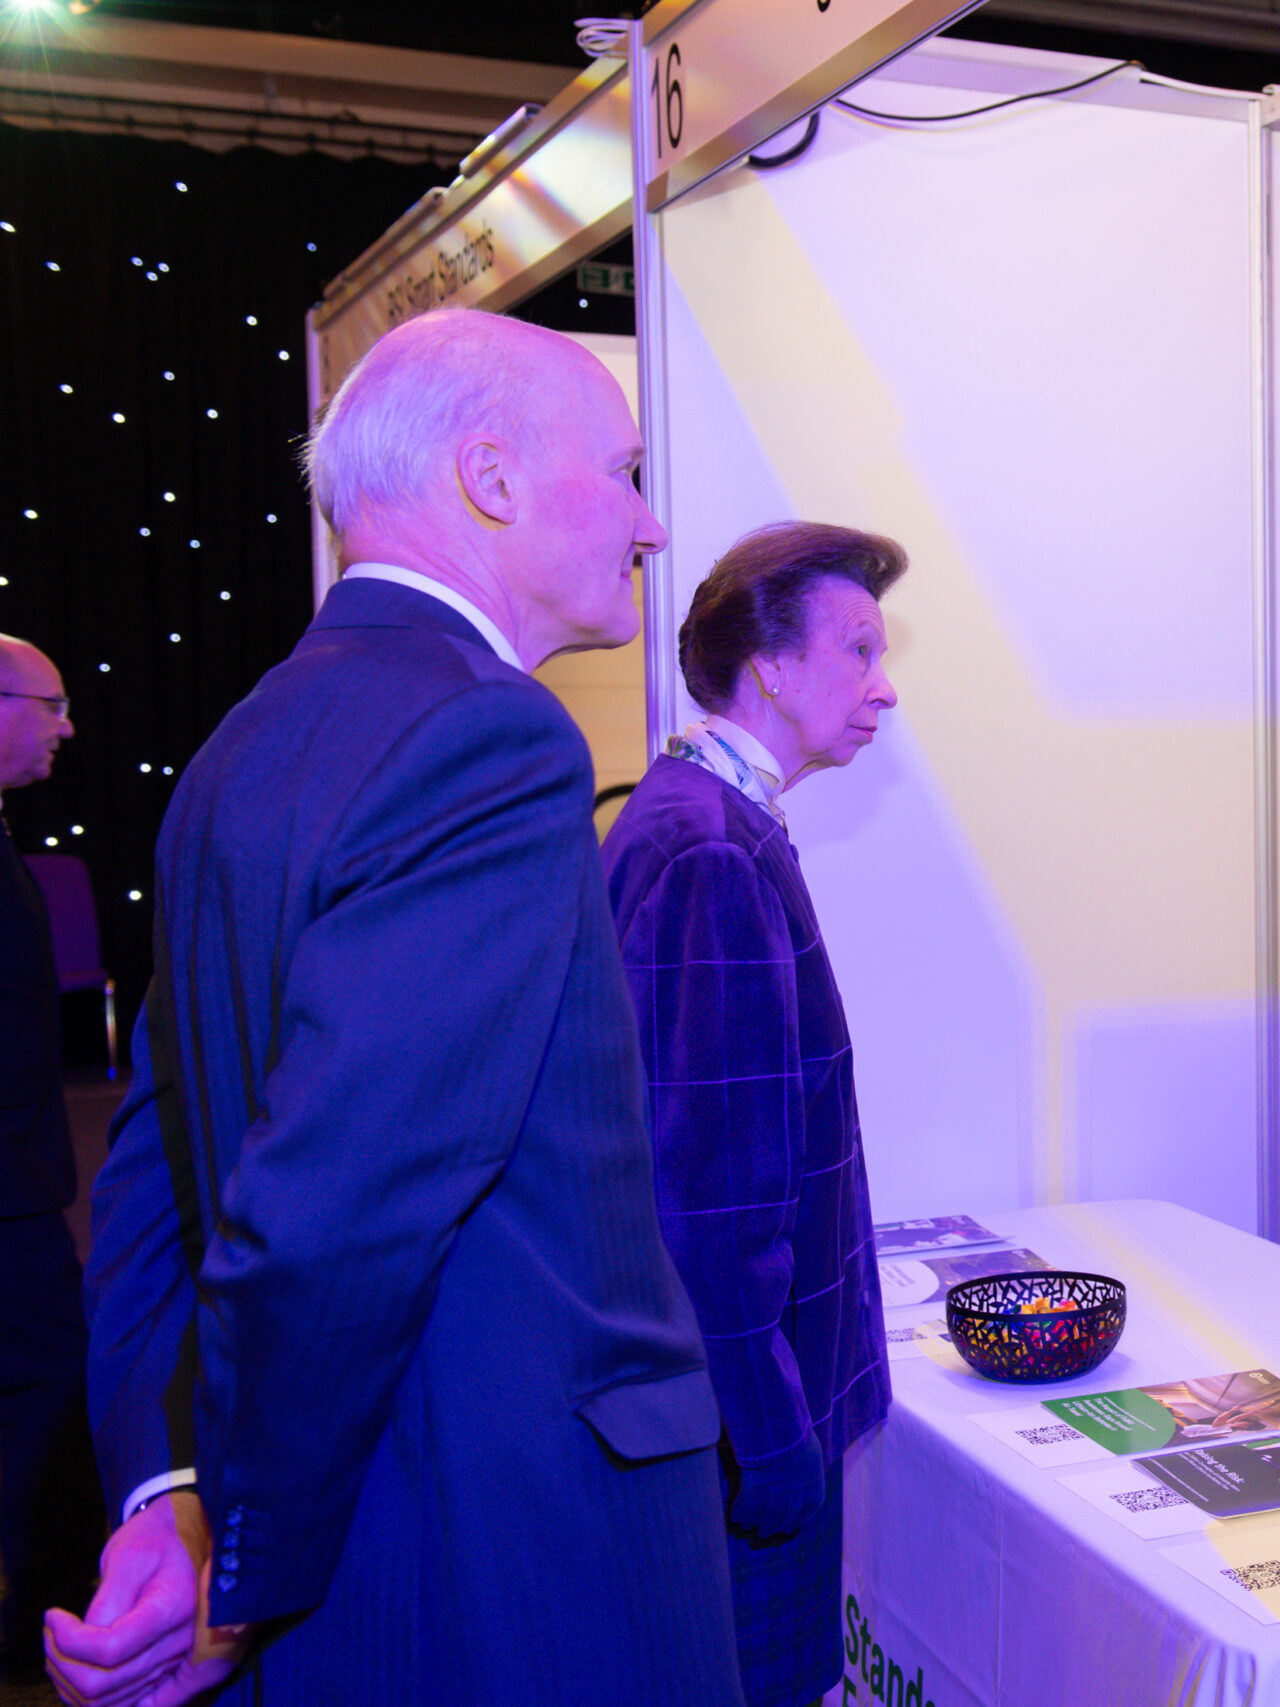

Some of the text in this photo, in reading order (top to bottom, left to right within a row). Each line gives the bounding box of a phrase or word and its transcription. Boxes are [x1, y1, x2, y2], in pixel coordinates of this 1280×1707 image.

[651, 42, 683, 159] 16
[438, 218, 495, 303] Standards
[845, 1594, 936, 1707] Stand
